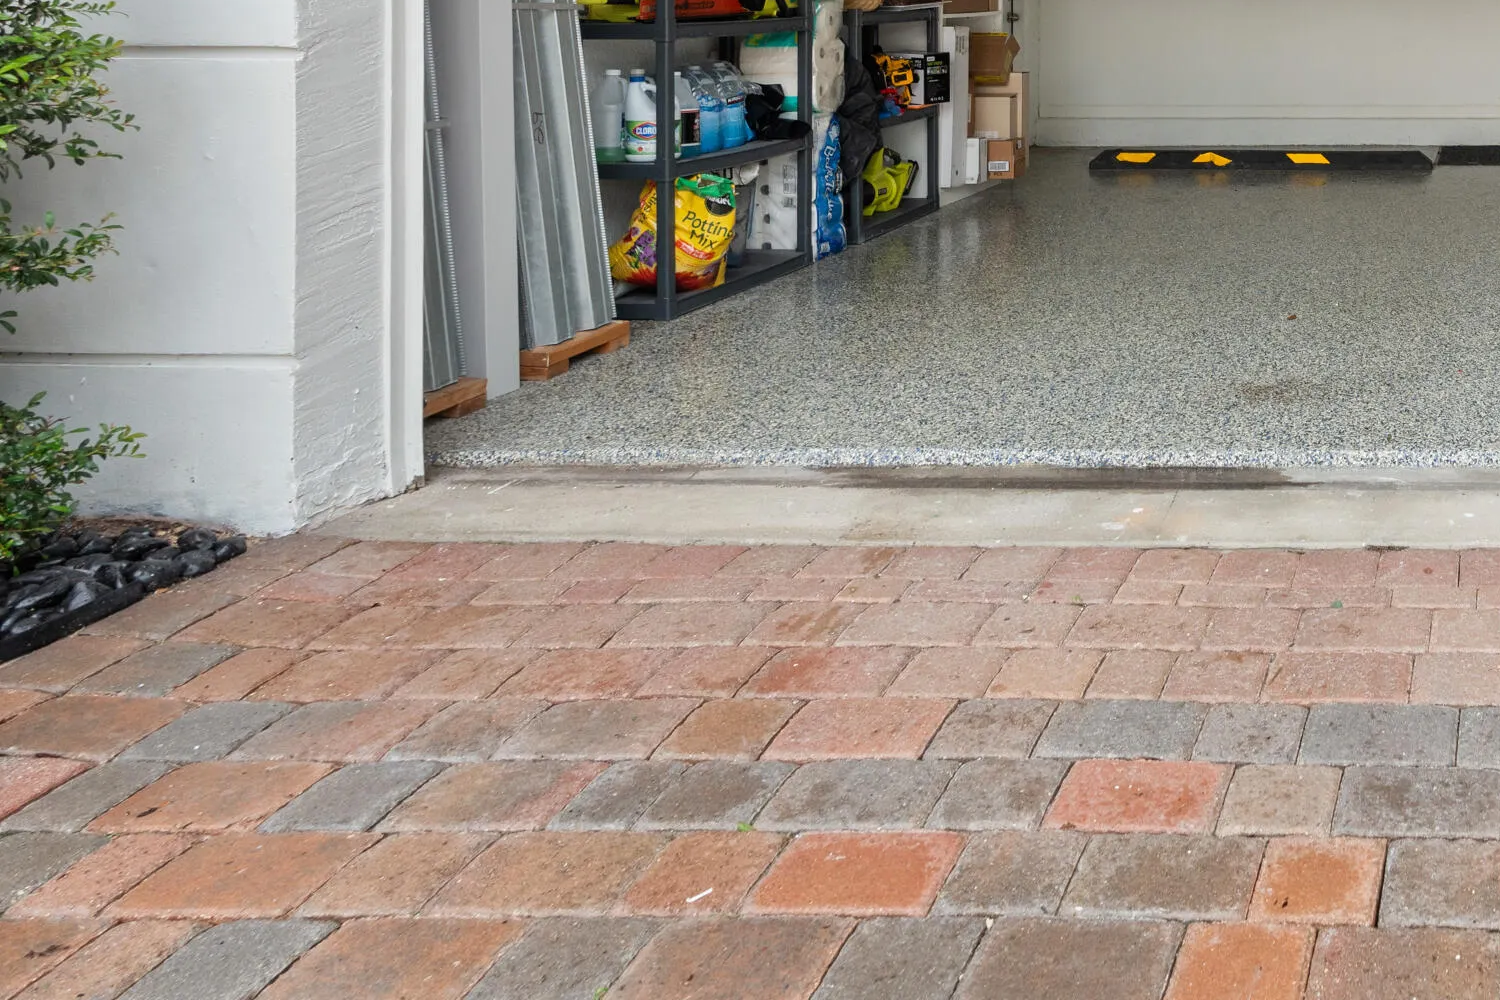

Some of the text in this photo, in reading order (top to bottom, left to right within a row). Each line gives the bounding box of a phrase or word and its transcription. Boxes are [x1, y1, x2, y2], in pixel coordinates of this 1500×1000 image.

[635, 126, 657, 135] CLORO
[682, 210, 734, 240] Potting
[690, 230, 719, 250] Mix
